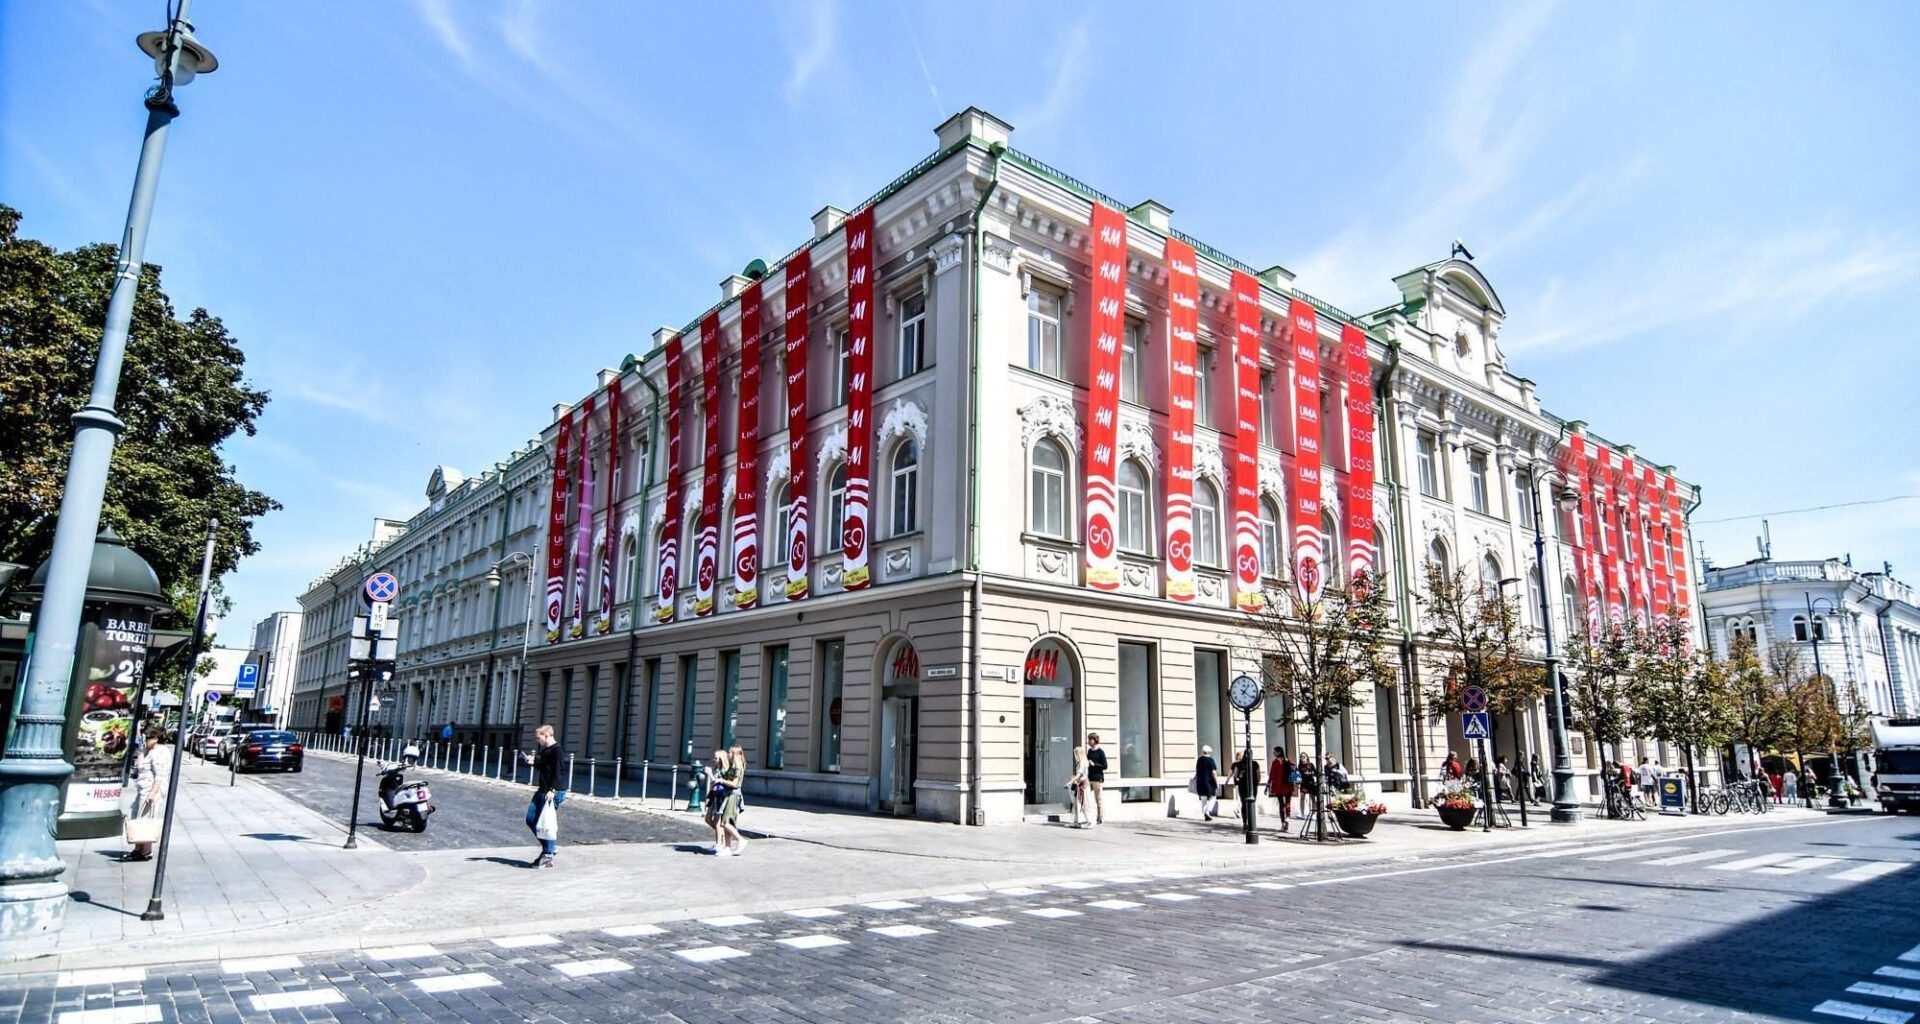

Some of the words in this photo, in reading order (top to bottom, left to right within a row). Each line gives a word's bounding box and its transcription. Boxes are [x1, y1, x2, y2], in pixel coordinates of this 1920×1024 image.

[1297, 316, 1312, 331] UMA
[1298, 346, 1315, 360] UMA
[1348, 344, 1368, 360] COS
[1299, 376, 1316, 390] UMA
[1350, 371, 1370, 387] COS
[1300, 405, 1317, 419] UMA
[1351, 399, 1372, 414] COS
[1351, 427, 1372, 443] COS
[1300, 436, 1318, 450] UMA
[1351, 457, 1372, 471] COS
[1300, 468, 1318, 481] UMA
[1352, 486, 1373, 500] COS
[1300, 500, 1318, 512] UMA
[1351, 515, 1372, 530] COS
[892, 647, 918, 680] H&M
[1025, 648, 1059, 681] H&M
[244, 666, 255, 679] P
